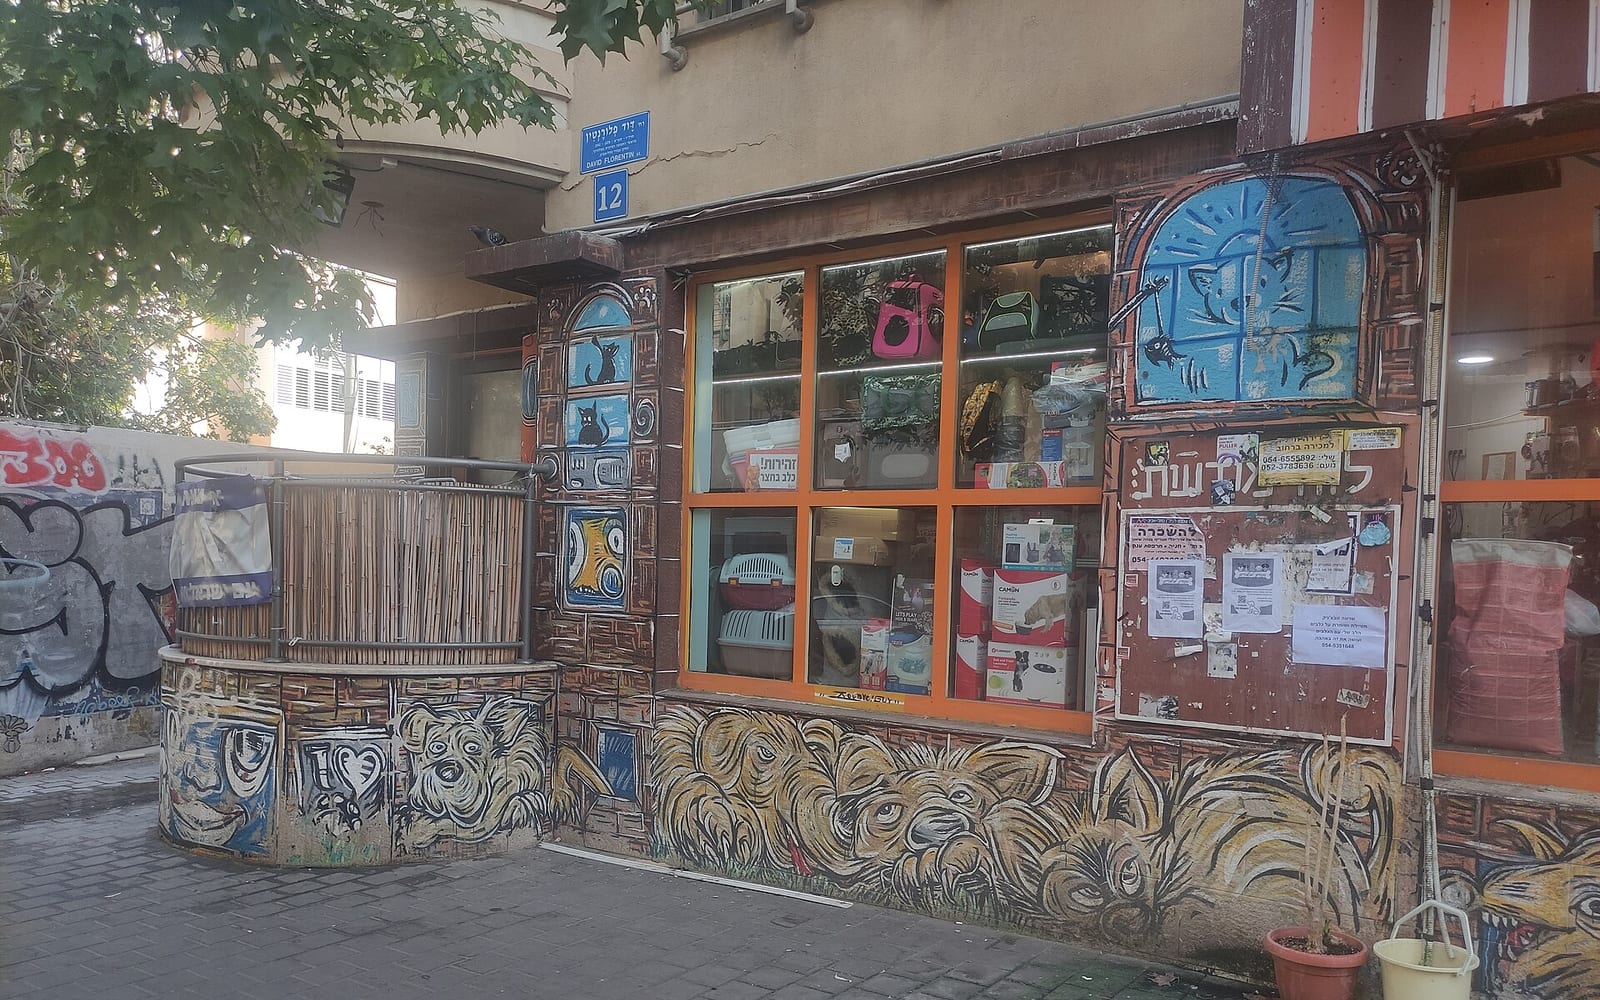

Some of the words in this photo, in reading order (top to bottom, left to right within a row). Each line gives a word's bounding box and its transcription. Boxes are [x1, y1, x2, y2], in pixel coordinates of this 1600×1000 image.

[586, 159, 602, 169] DAVID
[604, 151, 635, 164] FLORENTIN
[598, 182, 622, 212] 12
[760, 457, 797, 470] זהירות!
[1263, 454, 1315, 464] 054-6555892
[1261, 462, 1314, 471] 052-3783636
[760, 473, 780, 483] בחצר
[781, 472, 796, 483] כלב
[1138, 526, 1197, 537] להשכרה
